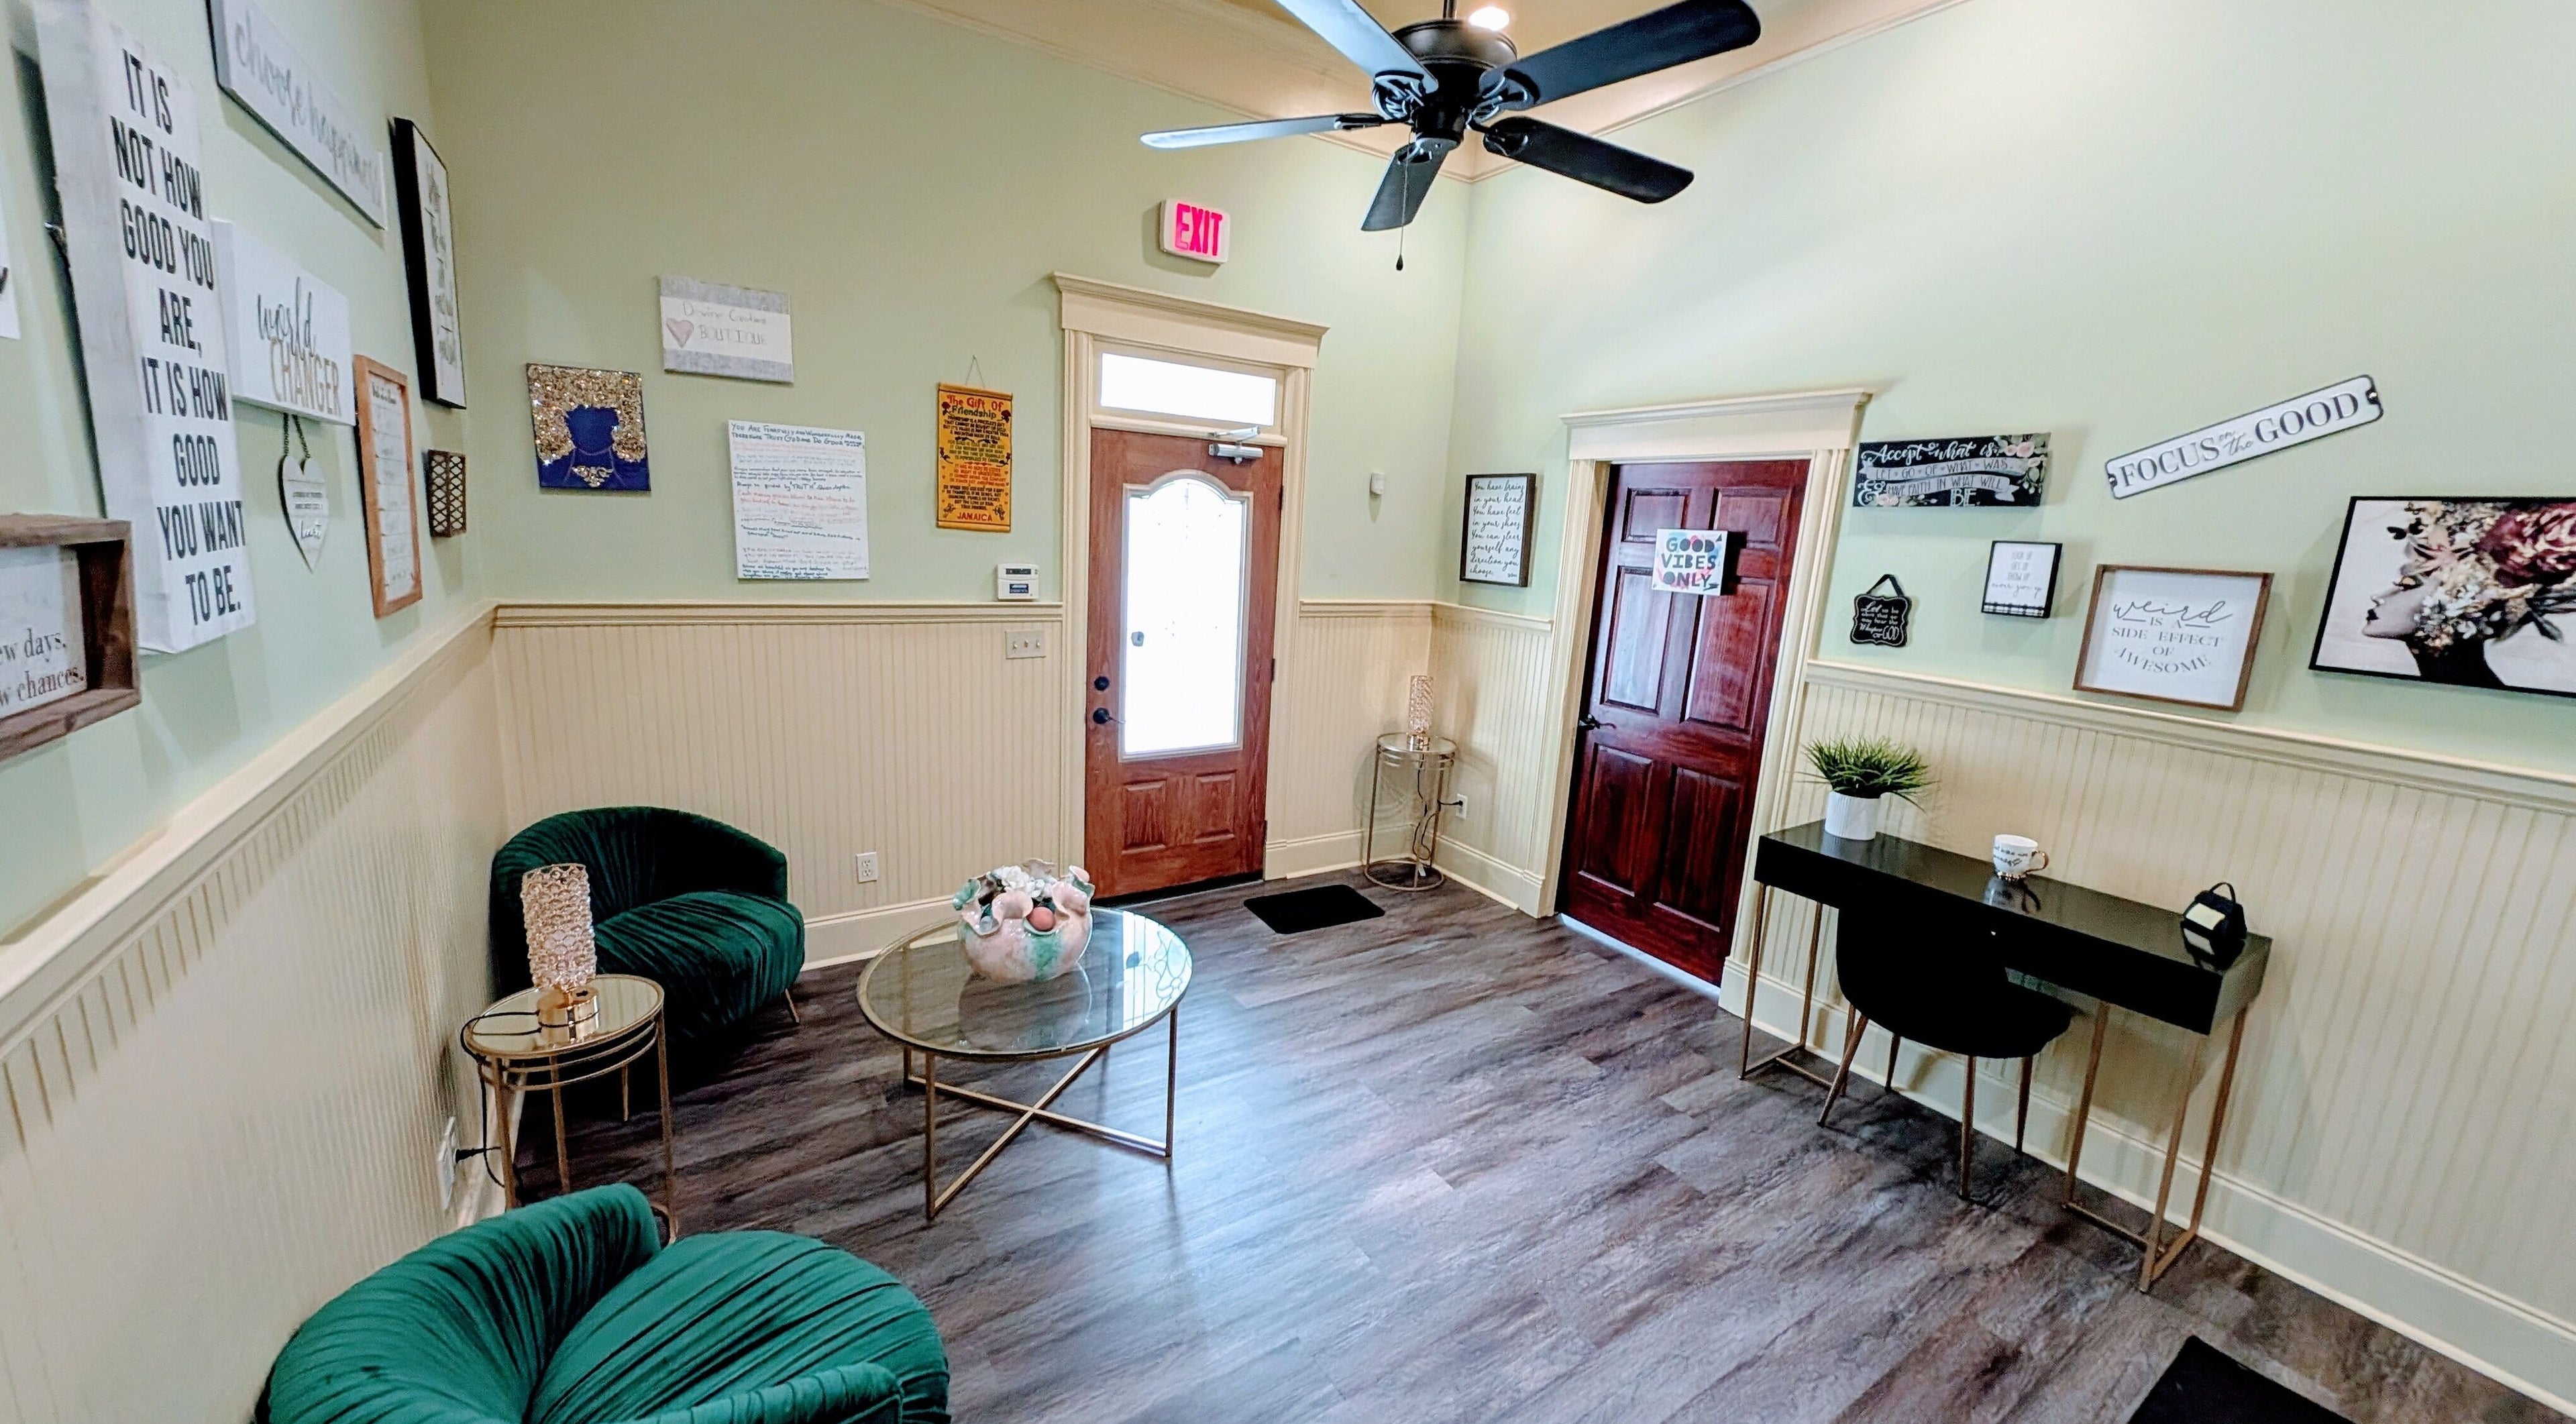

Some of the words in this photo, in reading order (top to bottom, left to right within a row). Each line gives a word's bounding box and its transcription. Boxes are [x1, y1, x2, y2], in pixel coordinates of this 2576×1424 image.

[122, 48, 146, 117] IT
[150, 70, 172, 135] IS
[111, 115, 157, 195] NOT
[160, 147, 203, 221] HOW
[1175, 203, 1223, 256] EXIT
[120, 198, 176, 274] GOOD
[178, 225, 214, 290] YOU
[159, 288, 202, 358] ARE,
[258, 276, 316, 361] world
[270, 336, 342, 417] CHANGER
[142, 358, 162, 414] IT
[166, 360, 186, 416] IS
[190, 364, 229, 421] HOW
[947, 394, 963, 406] The
[967, 397, 985, 408] Gift
[991, 401, 1004, 412] Of
[2255, 392, 2359, 443] GOOD
[2218, 430, 2237, 442] on
[2223, 432, 2253, 456] the
[173, 433, 221, 488] GOOD
[1861, 442, 1931, 465] Accept
[1934, 441, 1976, 460] what
[2119, 437, 2219, 487] FOCUS
[1876, 469, 1890, 480] LET
[1902, 468, 1915, 478] GO
[1925, 465, 1937, 476] OF
[1947, 460, 1972, 472] WHAT
[1475, 481, 1485, 492] You
[1487, 480, 1502, 490] have
[1937, 478, 1945, 490] IN
[1951, 476, 1974, 487] WHAT
[1980, 478, 2001, 489] WILL
[1473, 506, 1485, 516] You
[1487, 505, 1505, 515] have
[1505, 506, 1521, 517] feet
[1483, 497, 1501, 509] your
[957, 512, 992, 521] JAMAICA
[1481, 521, 1500, 533] your
[157, 503, 198, 561] YOU
[199, 500, 246, 555] WANT
[1472, 530, 1484, 539] You
[1505, 547, 1519, 559] any
[1666, 537, 1715, 553] GOOD
[1470, 553, 1503, 564] direction
[1502, 561, 1519, 571] you
[1661, 553, 1717, 569] VIBES
[1663, 571, 1711, 588] ONLY
[185, 572, 210, 625] TO
[213, 565, 241, 616] BE.
[2114, 600, 2233, 624] weird
[2151, 616, 2163, 626] IS
[24, 628, 66, 662] days.
[2113, 627, 2147, 639] SIDE
[2159, 632, 2222, 647] EFFECT
[2114, 647, 2211, 673] AWESOME
[2153, 647, 2172, 656] OF
[17, 667, 85, 702] chances.
